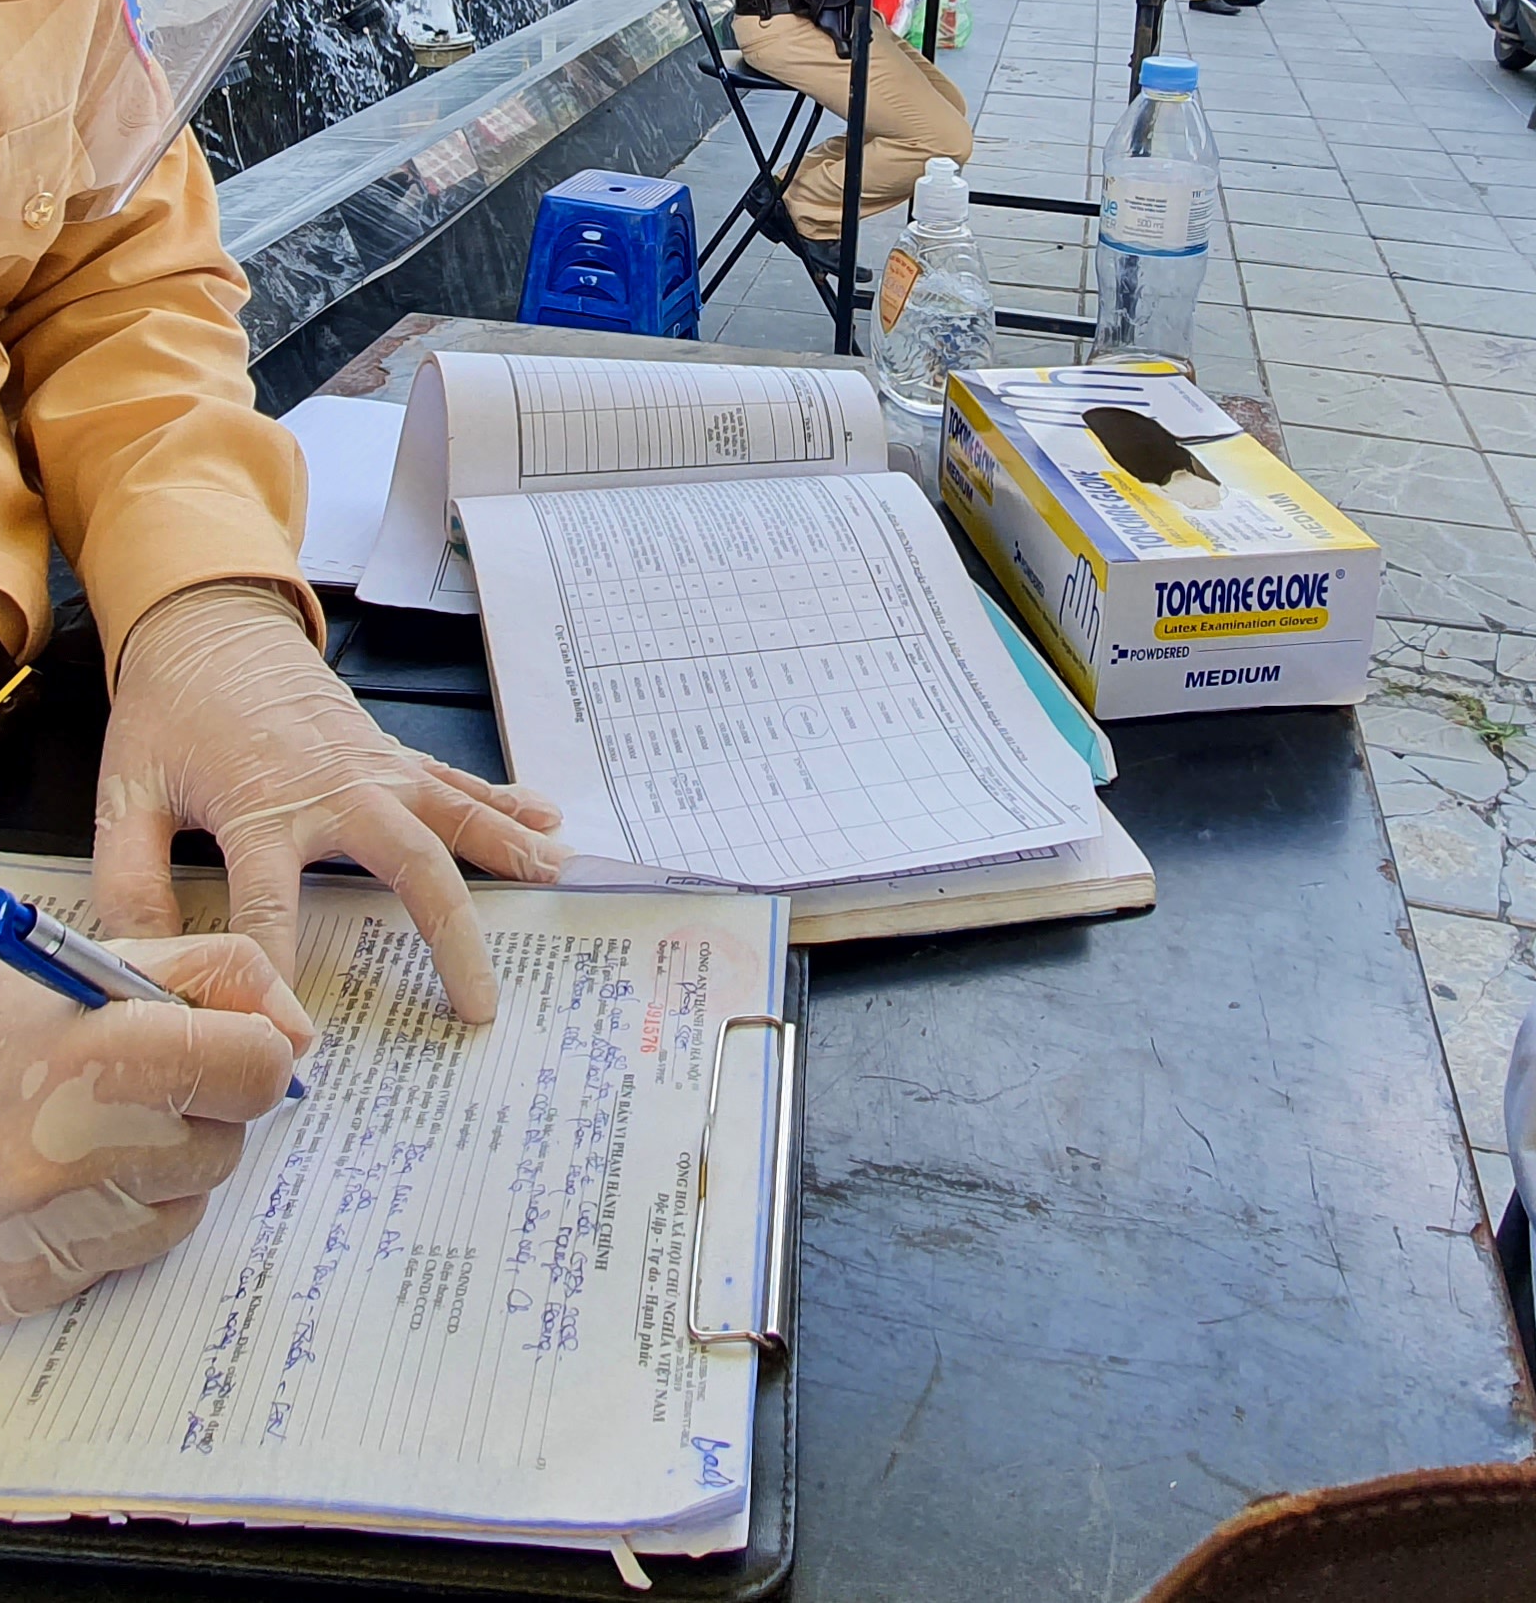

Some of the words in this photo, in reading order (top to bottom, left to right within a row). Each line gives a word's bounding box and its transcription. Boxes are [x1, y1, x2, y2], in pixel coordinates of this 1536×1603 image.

[1155, 577, 1255, 617] TOPCARE
[1257, 572, 1329, 611] GLOVE
[1164, 620, 1197, 634] Latex
[1200, 617, 1276, 632] Examination
[1279, 615, 1319, 627] Gloves
[1130, 646, 1190, 662] POWDERED
[1185, 665, 1281, 689] MEDIUM
[697, 941, 712, 972] CÔNG
[696, 974, 707, 990] AN
[692, 992, 707, 1027] THÀNH
[690, 1028, 704, 1046] PHỐ
[689, 1047, 703, 1060] HÀ
[686, 1062, 701, 1080] NỘI
[620, 1073, 636, 1099] BIÊN
[616, 1101, 631, 1124] BẢN
[613, 1125, 627, 1139] VI
[607, 1141, 624, 1178] PHẠM
[674, 1151, 691, 1188] CỘNG
[601, 1181, 620, 1219] HÀNH
[653, 1192, 669, 1214] Độc
[672, 1190, 689, 1217] HOÀ
[649, 1219, 666, 1235] lập
[670, 1221, 687, 1238] XÃ
[593, 1222, 615, 1271] CHÍNH
[645, 1246, 664, 1265] Tự
[665, 1240, 683, 1266] HỘI
[646, 1266, 661, 1283] do
[663, 1268, 681, 1297] CHỦ
[640, 1293, 657, 1329] Hạnh
[658, 1299, 679, 1347] NGHĨA
[634, 1332, 654, 1367] phúc
[653, 1351, 672, 1386] VIỆT
[651, 1387, 667, 1423] NAM
